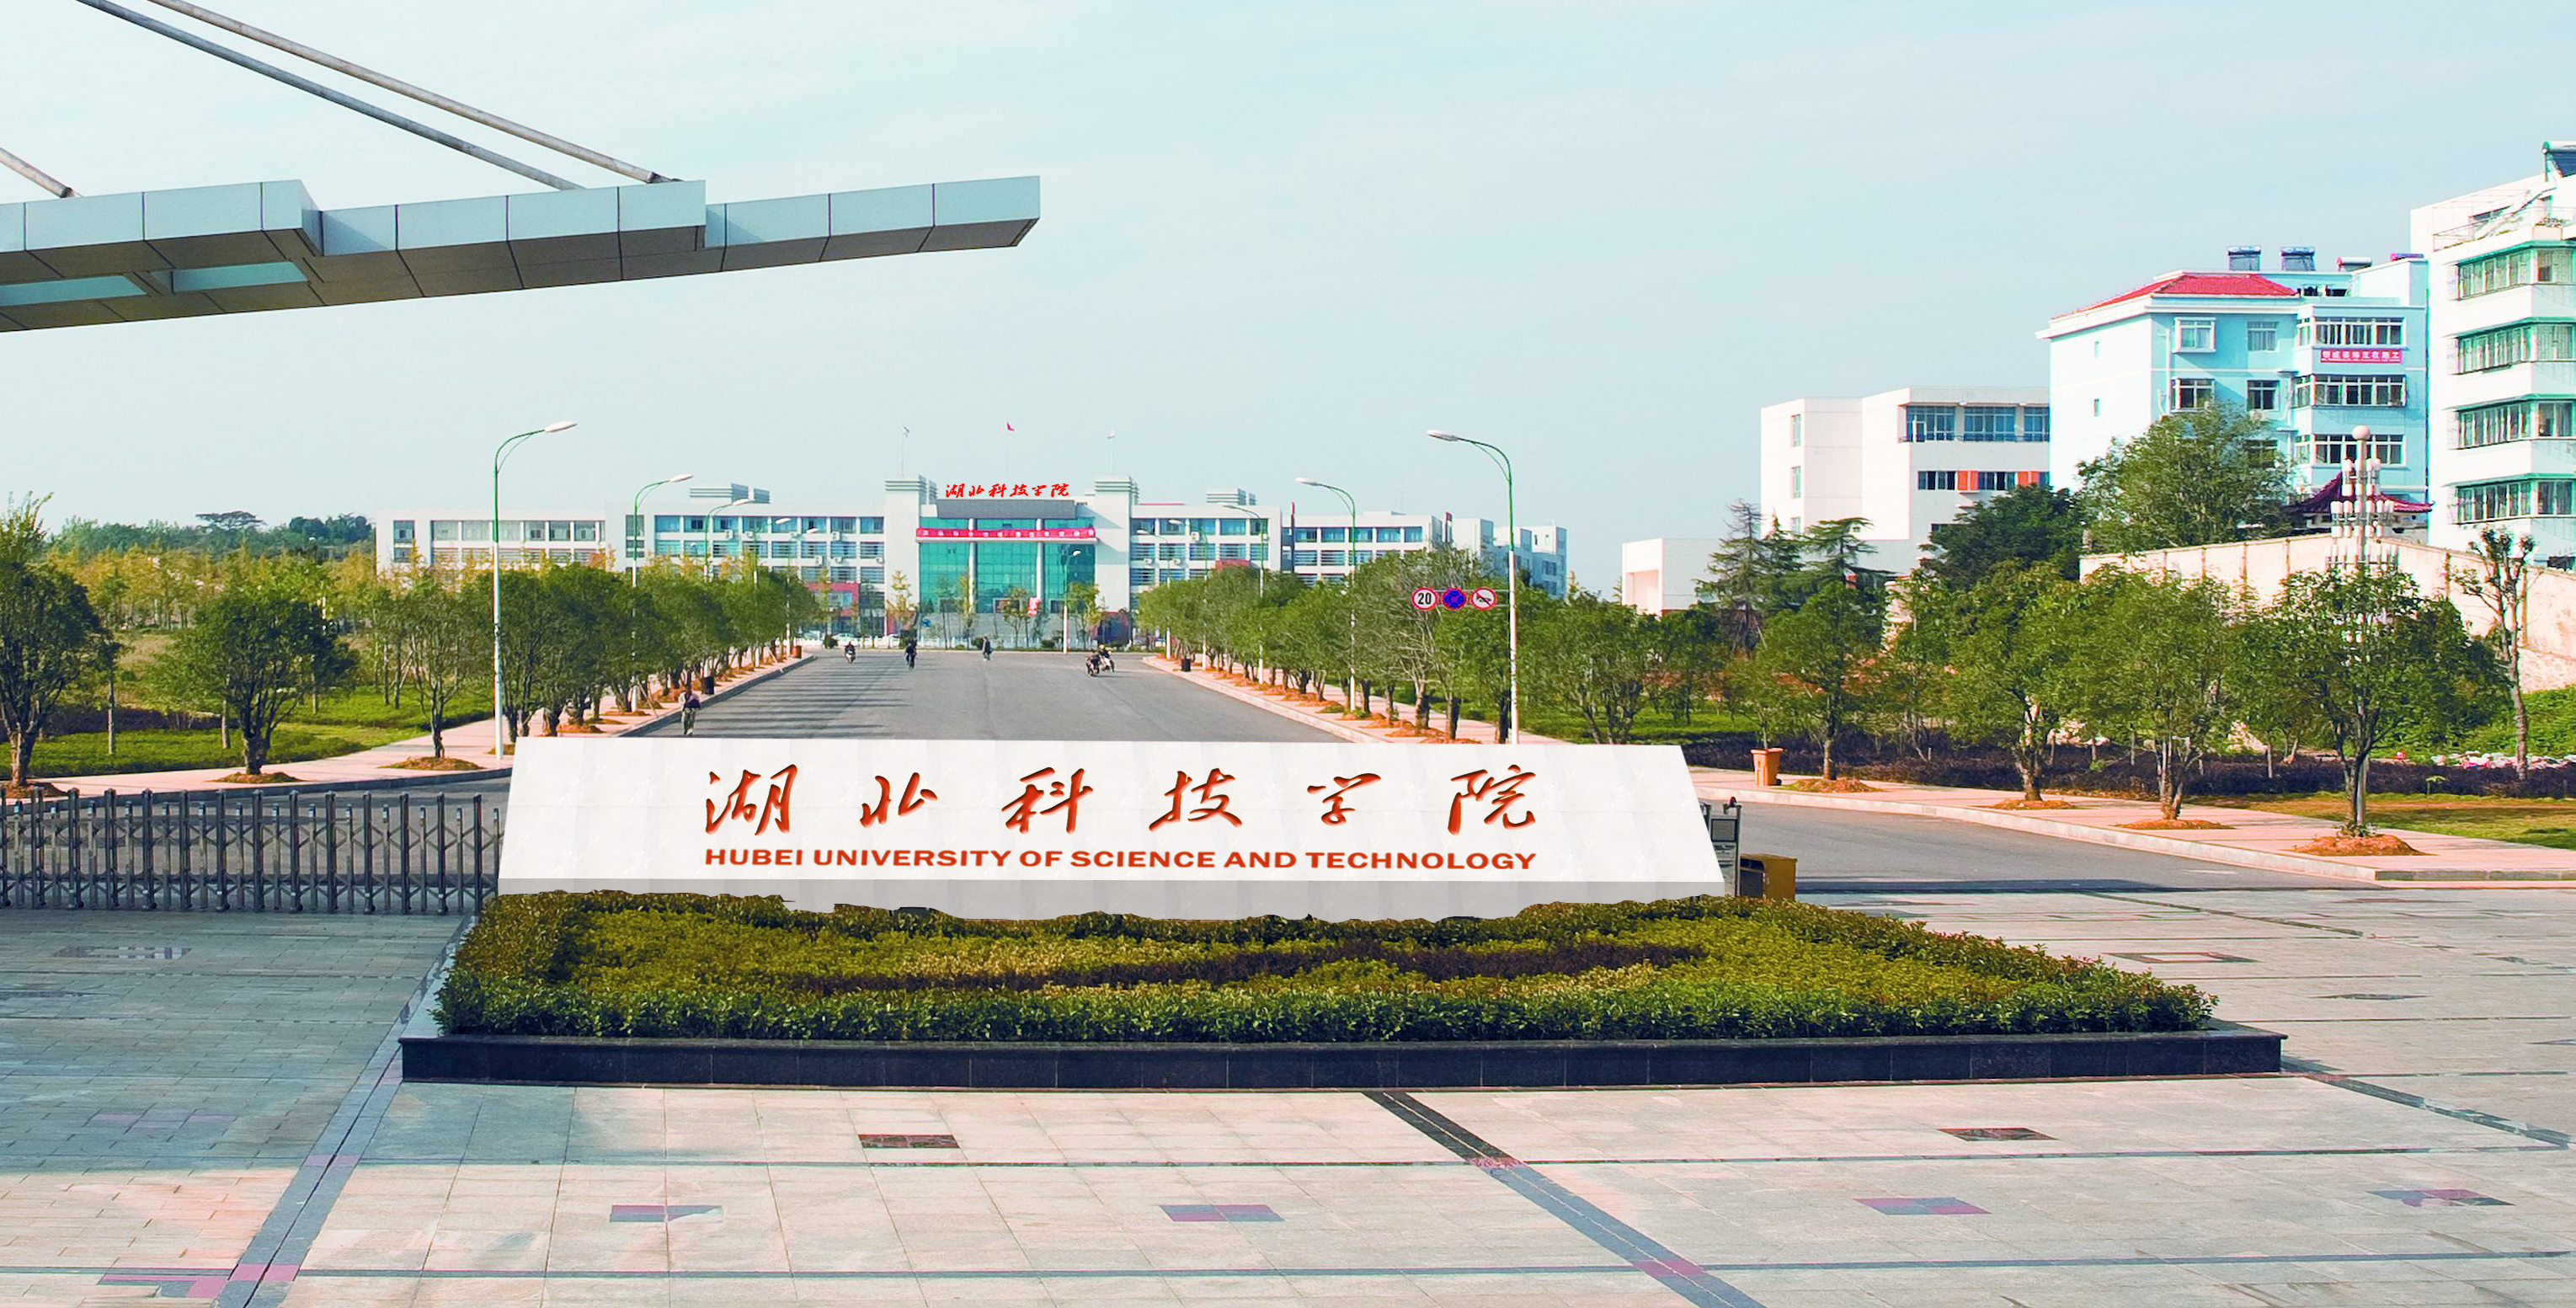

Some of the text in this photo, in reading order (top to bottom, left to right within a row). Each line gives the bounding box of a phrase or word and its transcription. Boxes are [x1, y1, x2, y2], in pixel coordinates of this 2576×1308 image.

[946, 483, 1069, 498] 湖北科技学院
[1417, 592, 1432, 605] 20
[706, 764, 1537, 836] 湖北科技学院
[706, 849, 1537, 869] HUBEI UNIVERSITY OF SCIENCE AND TECHNOLOGY
